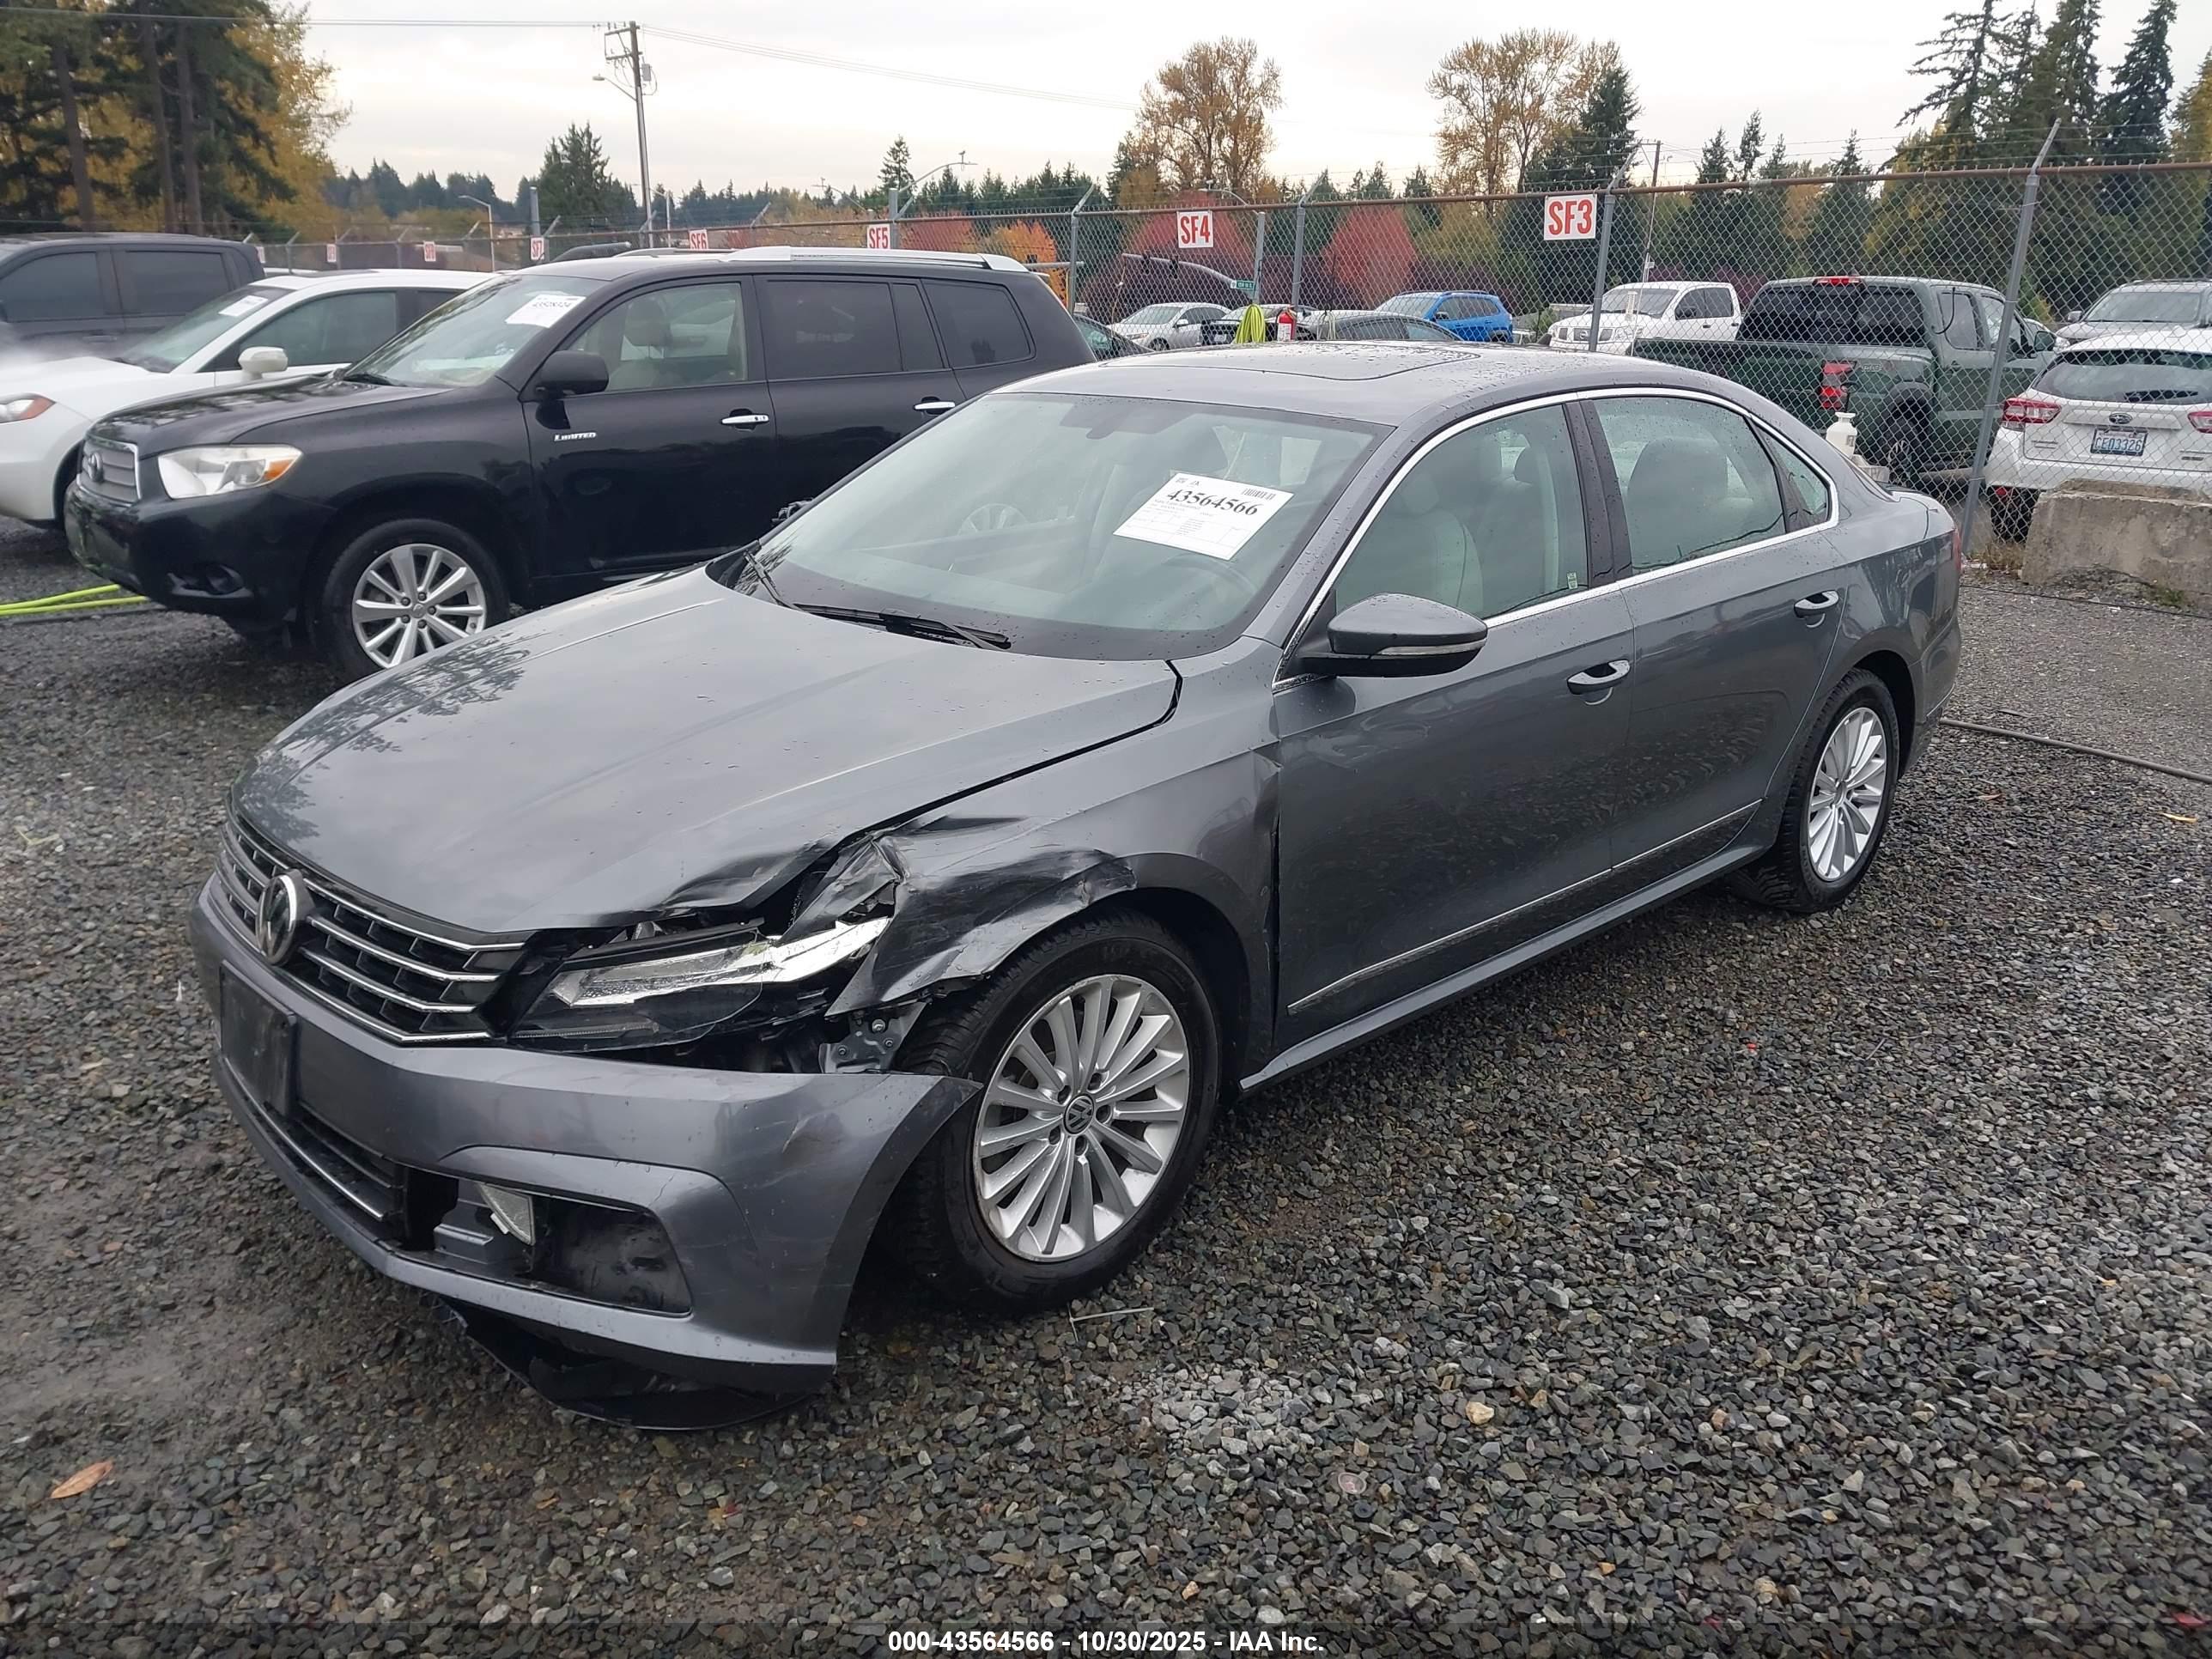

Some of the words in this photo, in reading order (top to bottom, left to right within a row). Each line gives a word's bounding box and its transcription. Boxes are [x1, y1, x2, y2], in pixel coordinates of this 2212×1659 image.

[1180, 215, 1211, 245] SF4
[1548, 199, 1593, 235] SF3
[690, 233, 707, 249] SF6
[868, 227, 889, 249] SF5
[1167, 489, 1262, 516] 43564566
